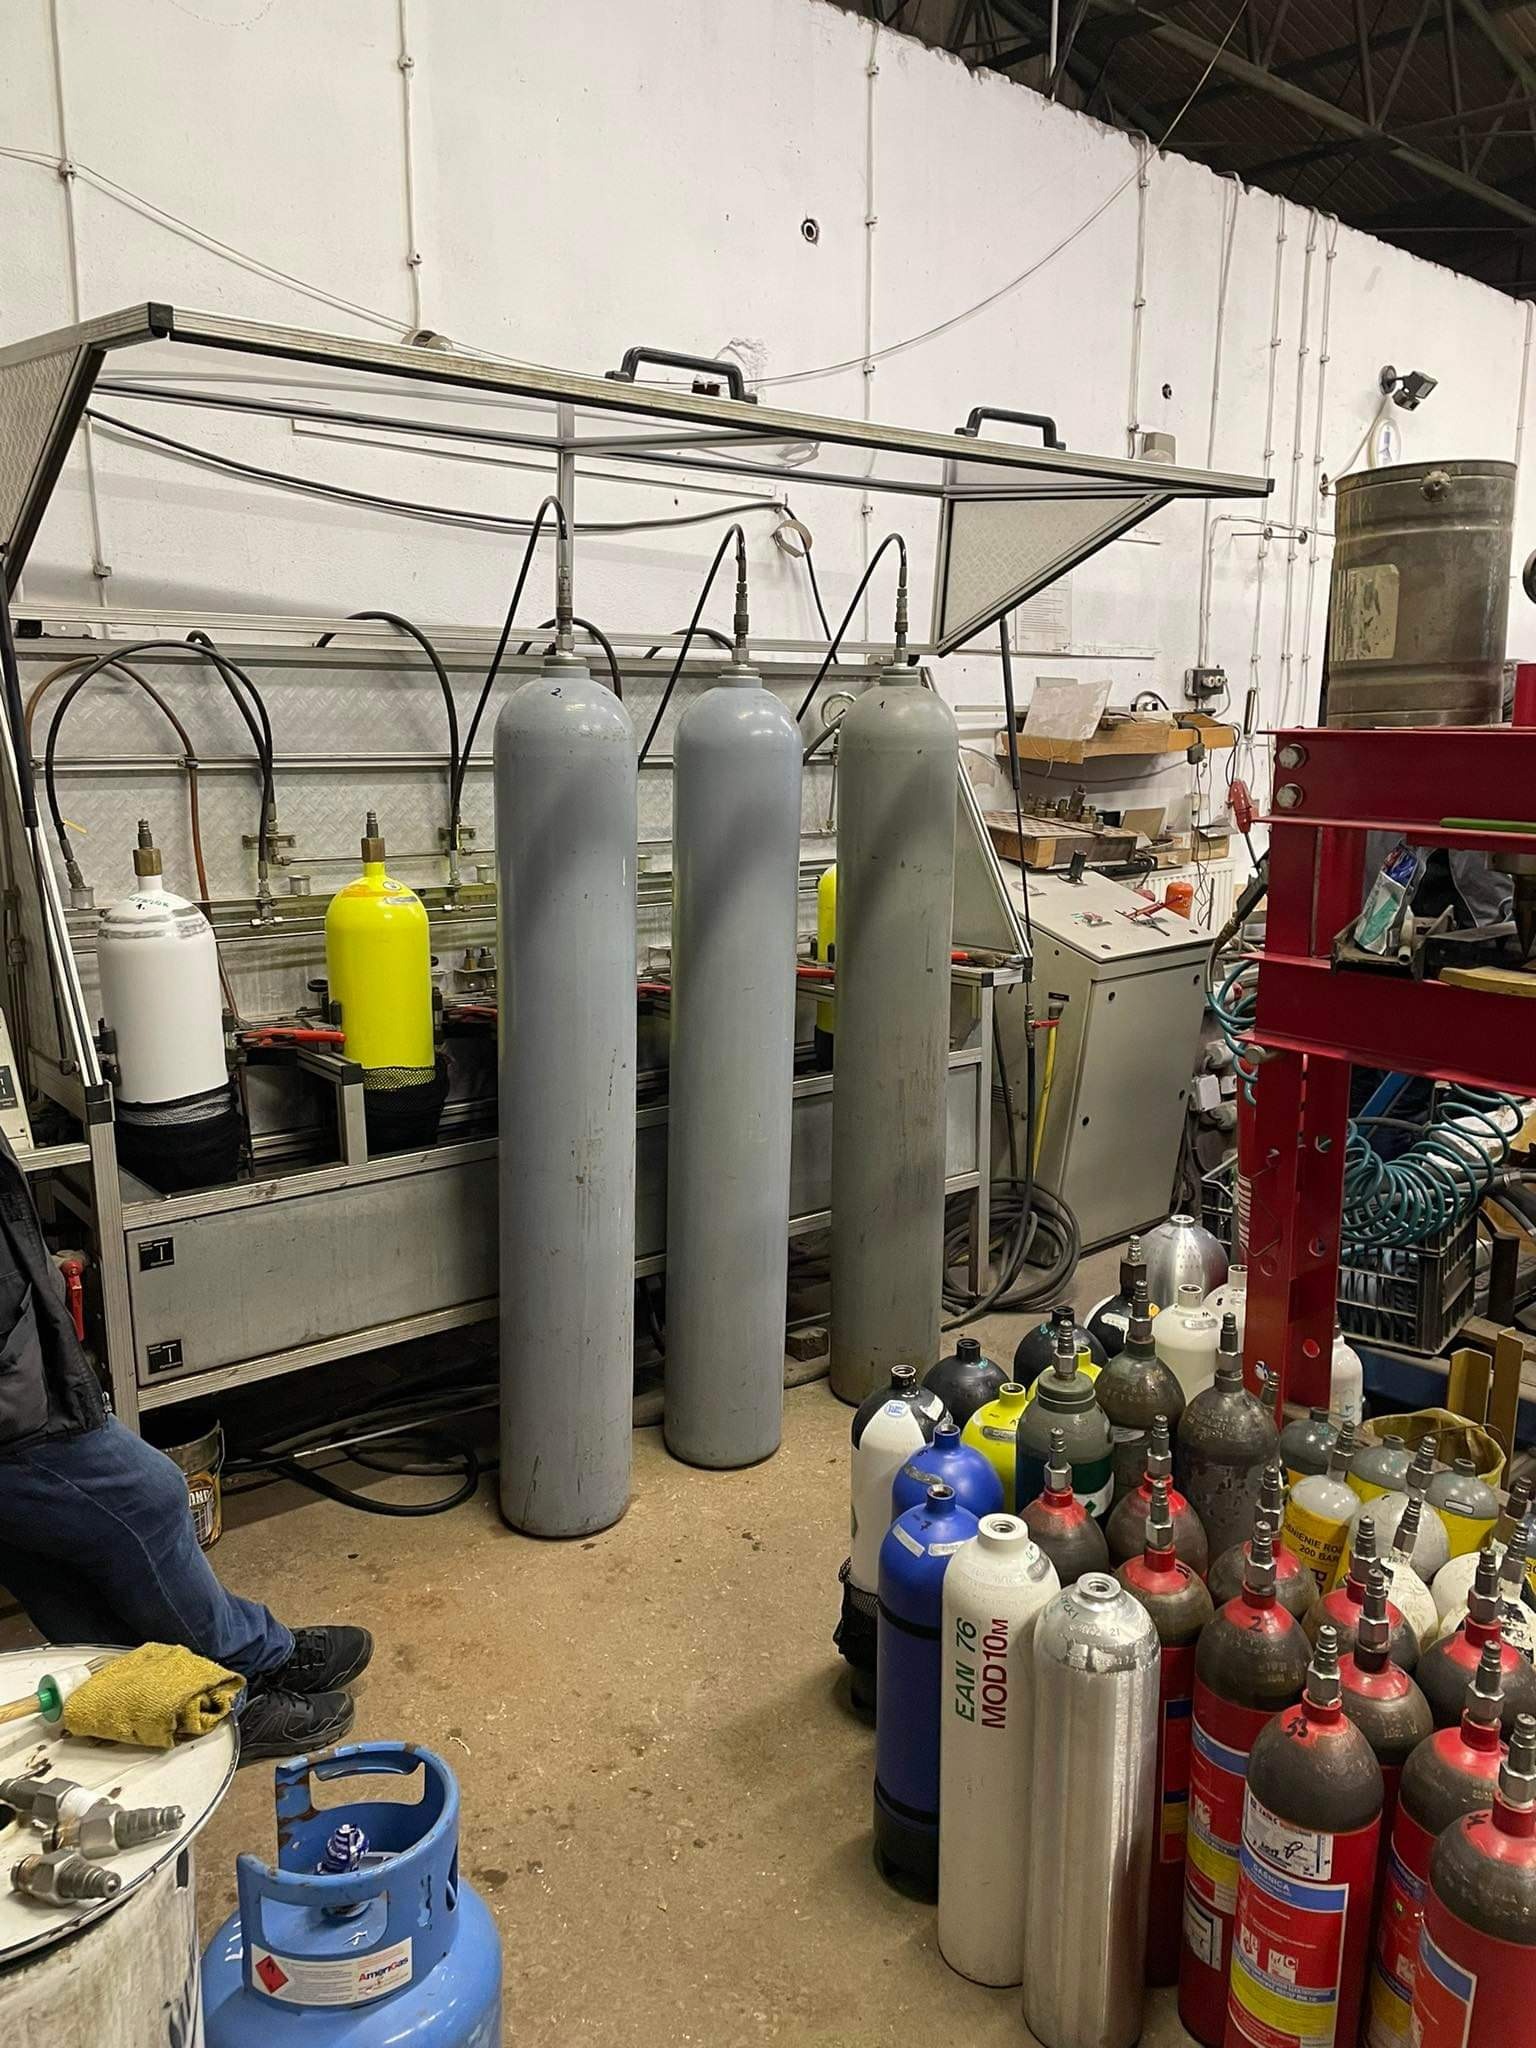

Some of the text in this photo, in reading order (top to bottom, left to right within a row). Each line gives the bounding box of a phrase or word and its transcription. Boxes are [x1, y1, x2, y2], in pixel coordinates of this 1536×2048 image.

[1299, 1544, 1316, 1558] 200
[955, 1616, 977, 1723] EAN 76
[358, 1957, 409, 1981] AmeriGas
